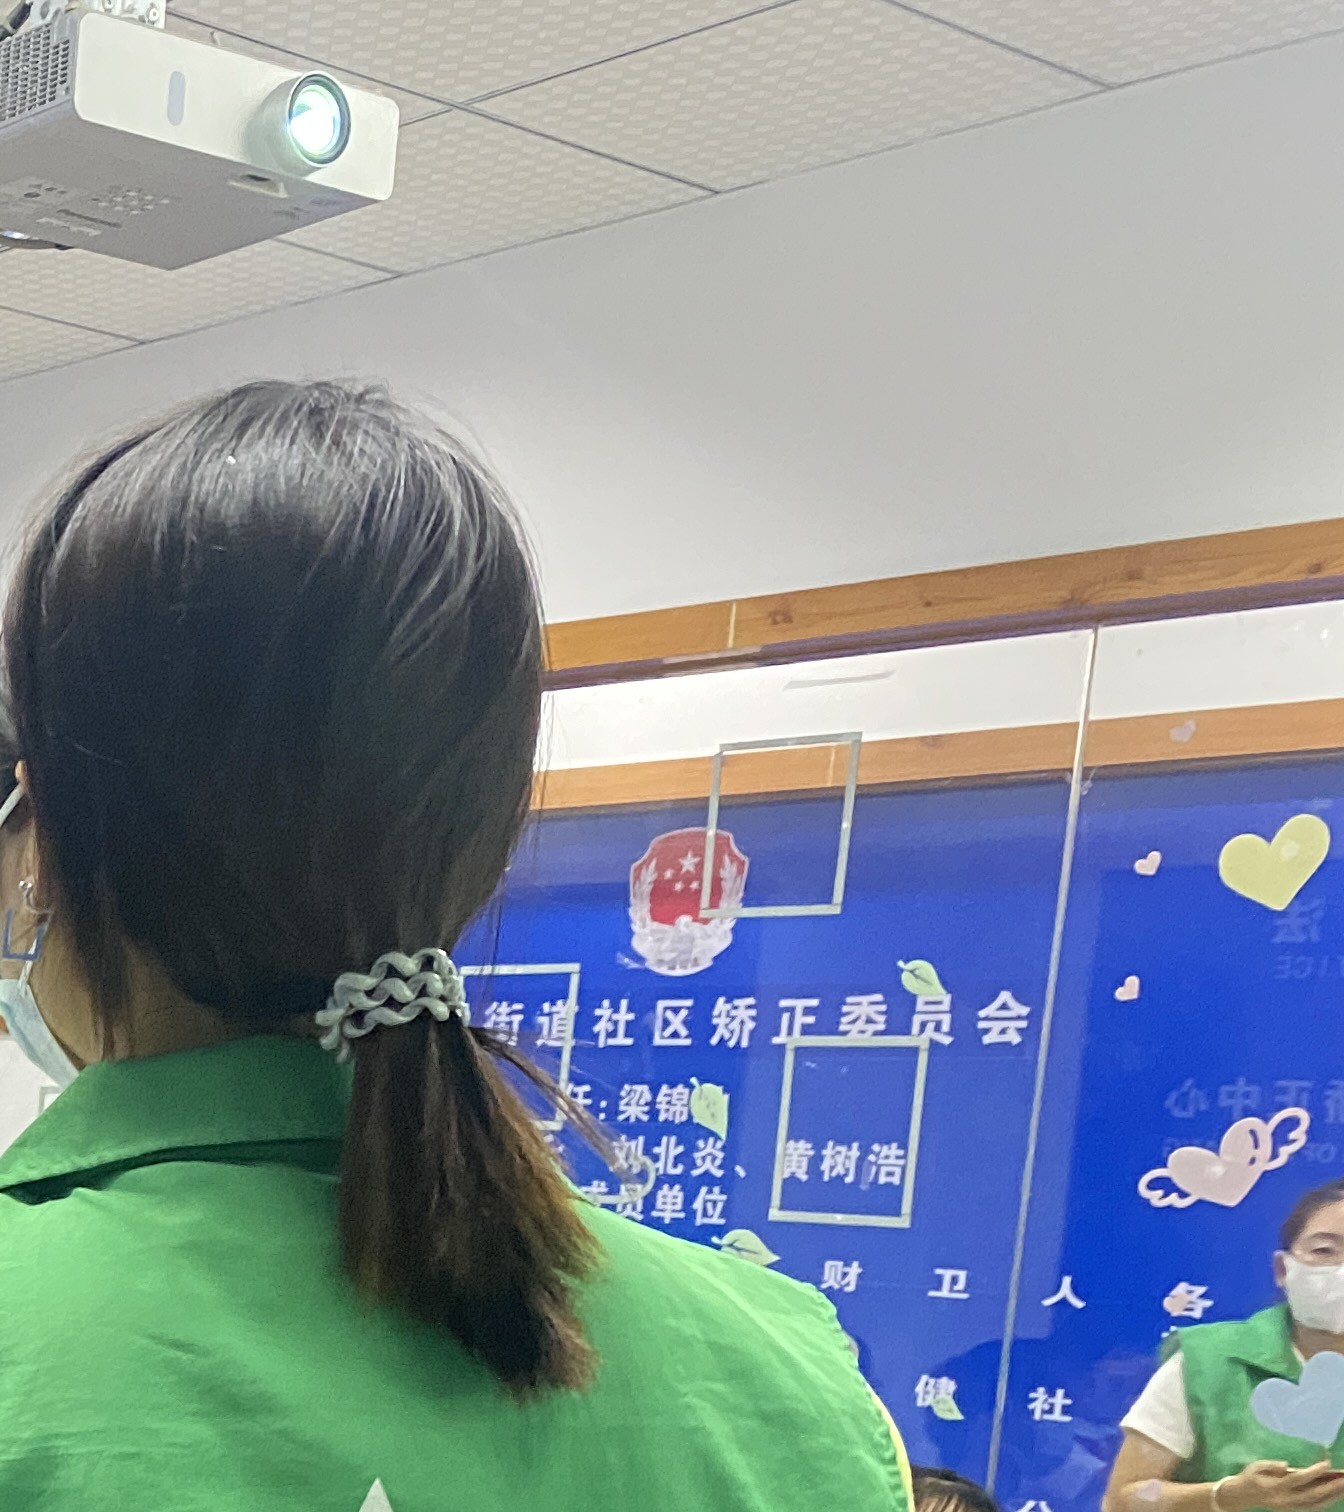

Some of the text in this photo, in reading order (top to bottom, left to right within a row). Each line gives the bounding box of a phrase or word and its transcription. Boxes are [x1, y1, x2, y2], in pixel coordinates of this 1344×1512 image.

[564, 1082, 730, 1124] 任:梁锦
[820, 1259, 864, 1293] 财
